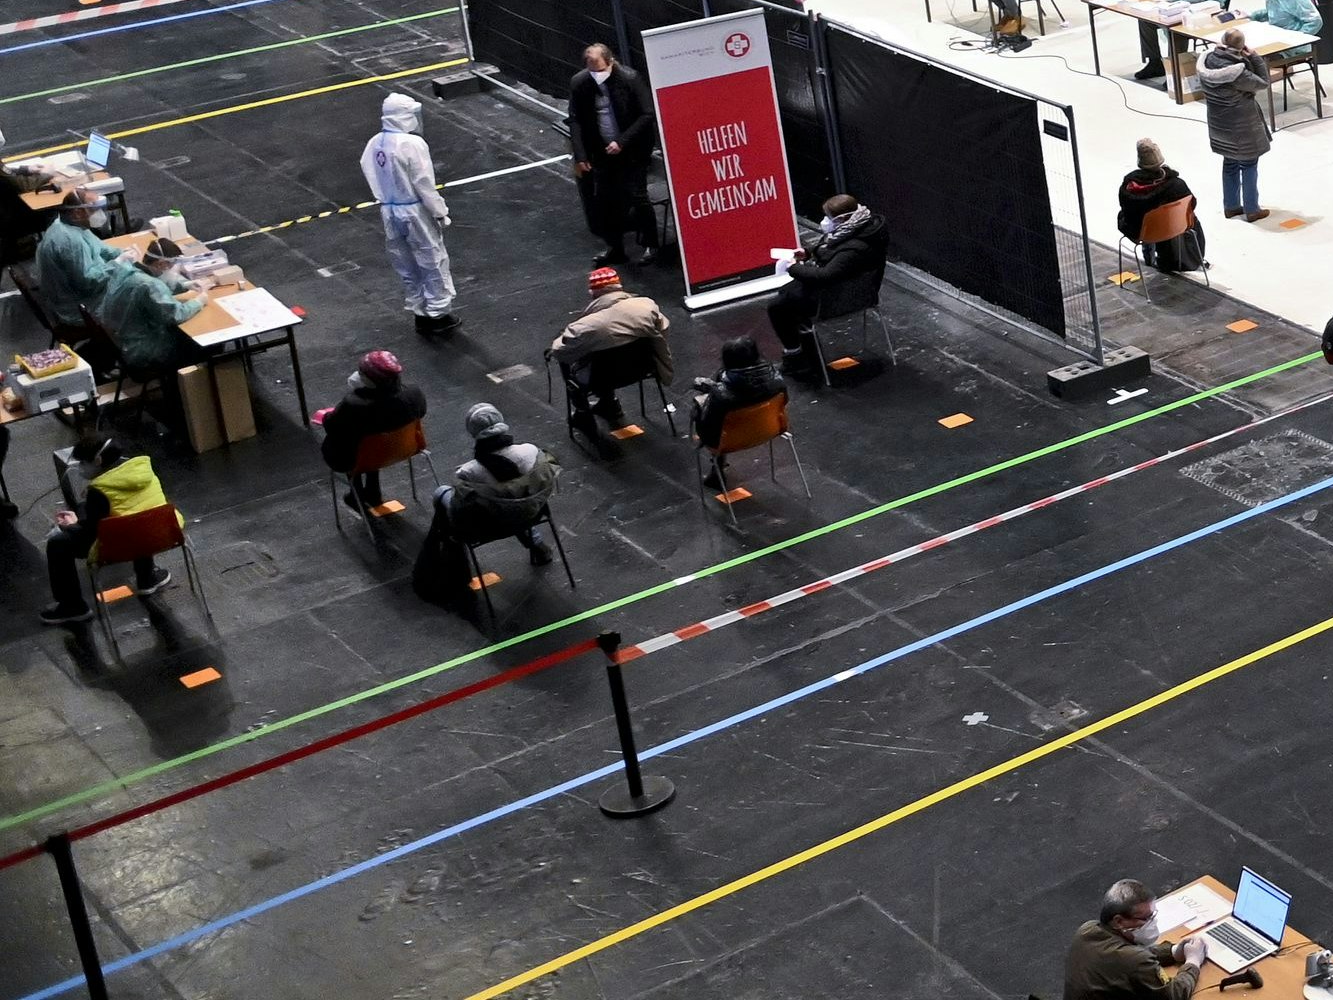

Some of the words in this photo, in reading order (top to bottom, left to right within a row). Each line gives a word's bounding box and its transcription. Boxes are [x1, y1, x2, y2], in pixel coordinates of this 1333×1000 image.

[697, 120, 748, 154] HELFEN
[711, 153, 744, 182] WIR
[687, 175, 778, 219] GEMEINSAM
